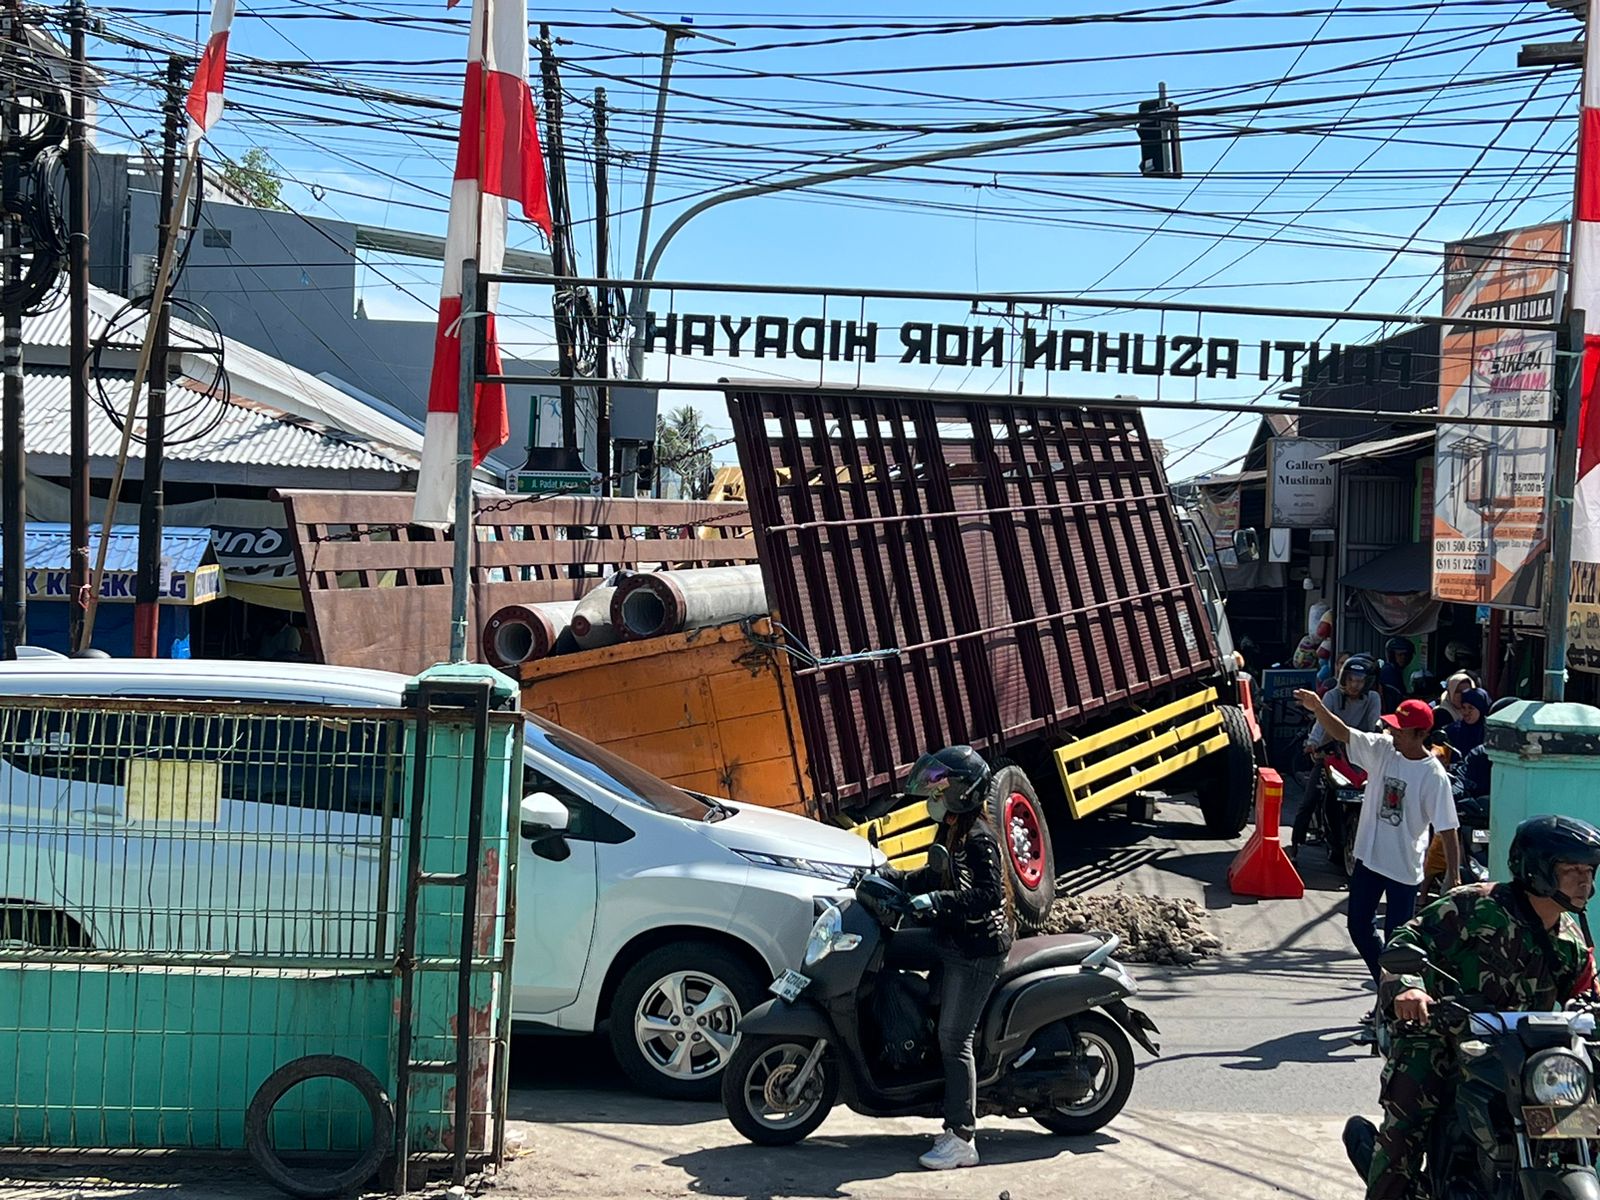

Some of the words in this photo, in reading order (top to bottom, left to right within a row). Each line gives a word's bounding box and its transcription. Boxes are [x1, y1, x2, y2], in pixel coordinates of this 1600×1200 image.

[1509, 298, 1552, 320] DIBUKA
[1286, 460, 1326, 472] Gallery
[1279, 475, 1332, 485] Muslimah
[1453, 541, 1466, 552] 500
[1453, 559, 1463, 570] 51
[1464, 558, 1477, 570] 222
[47, 572, 186, 598] KIGKOG
